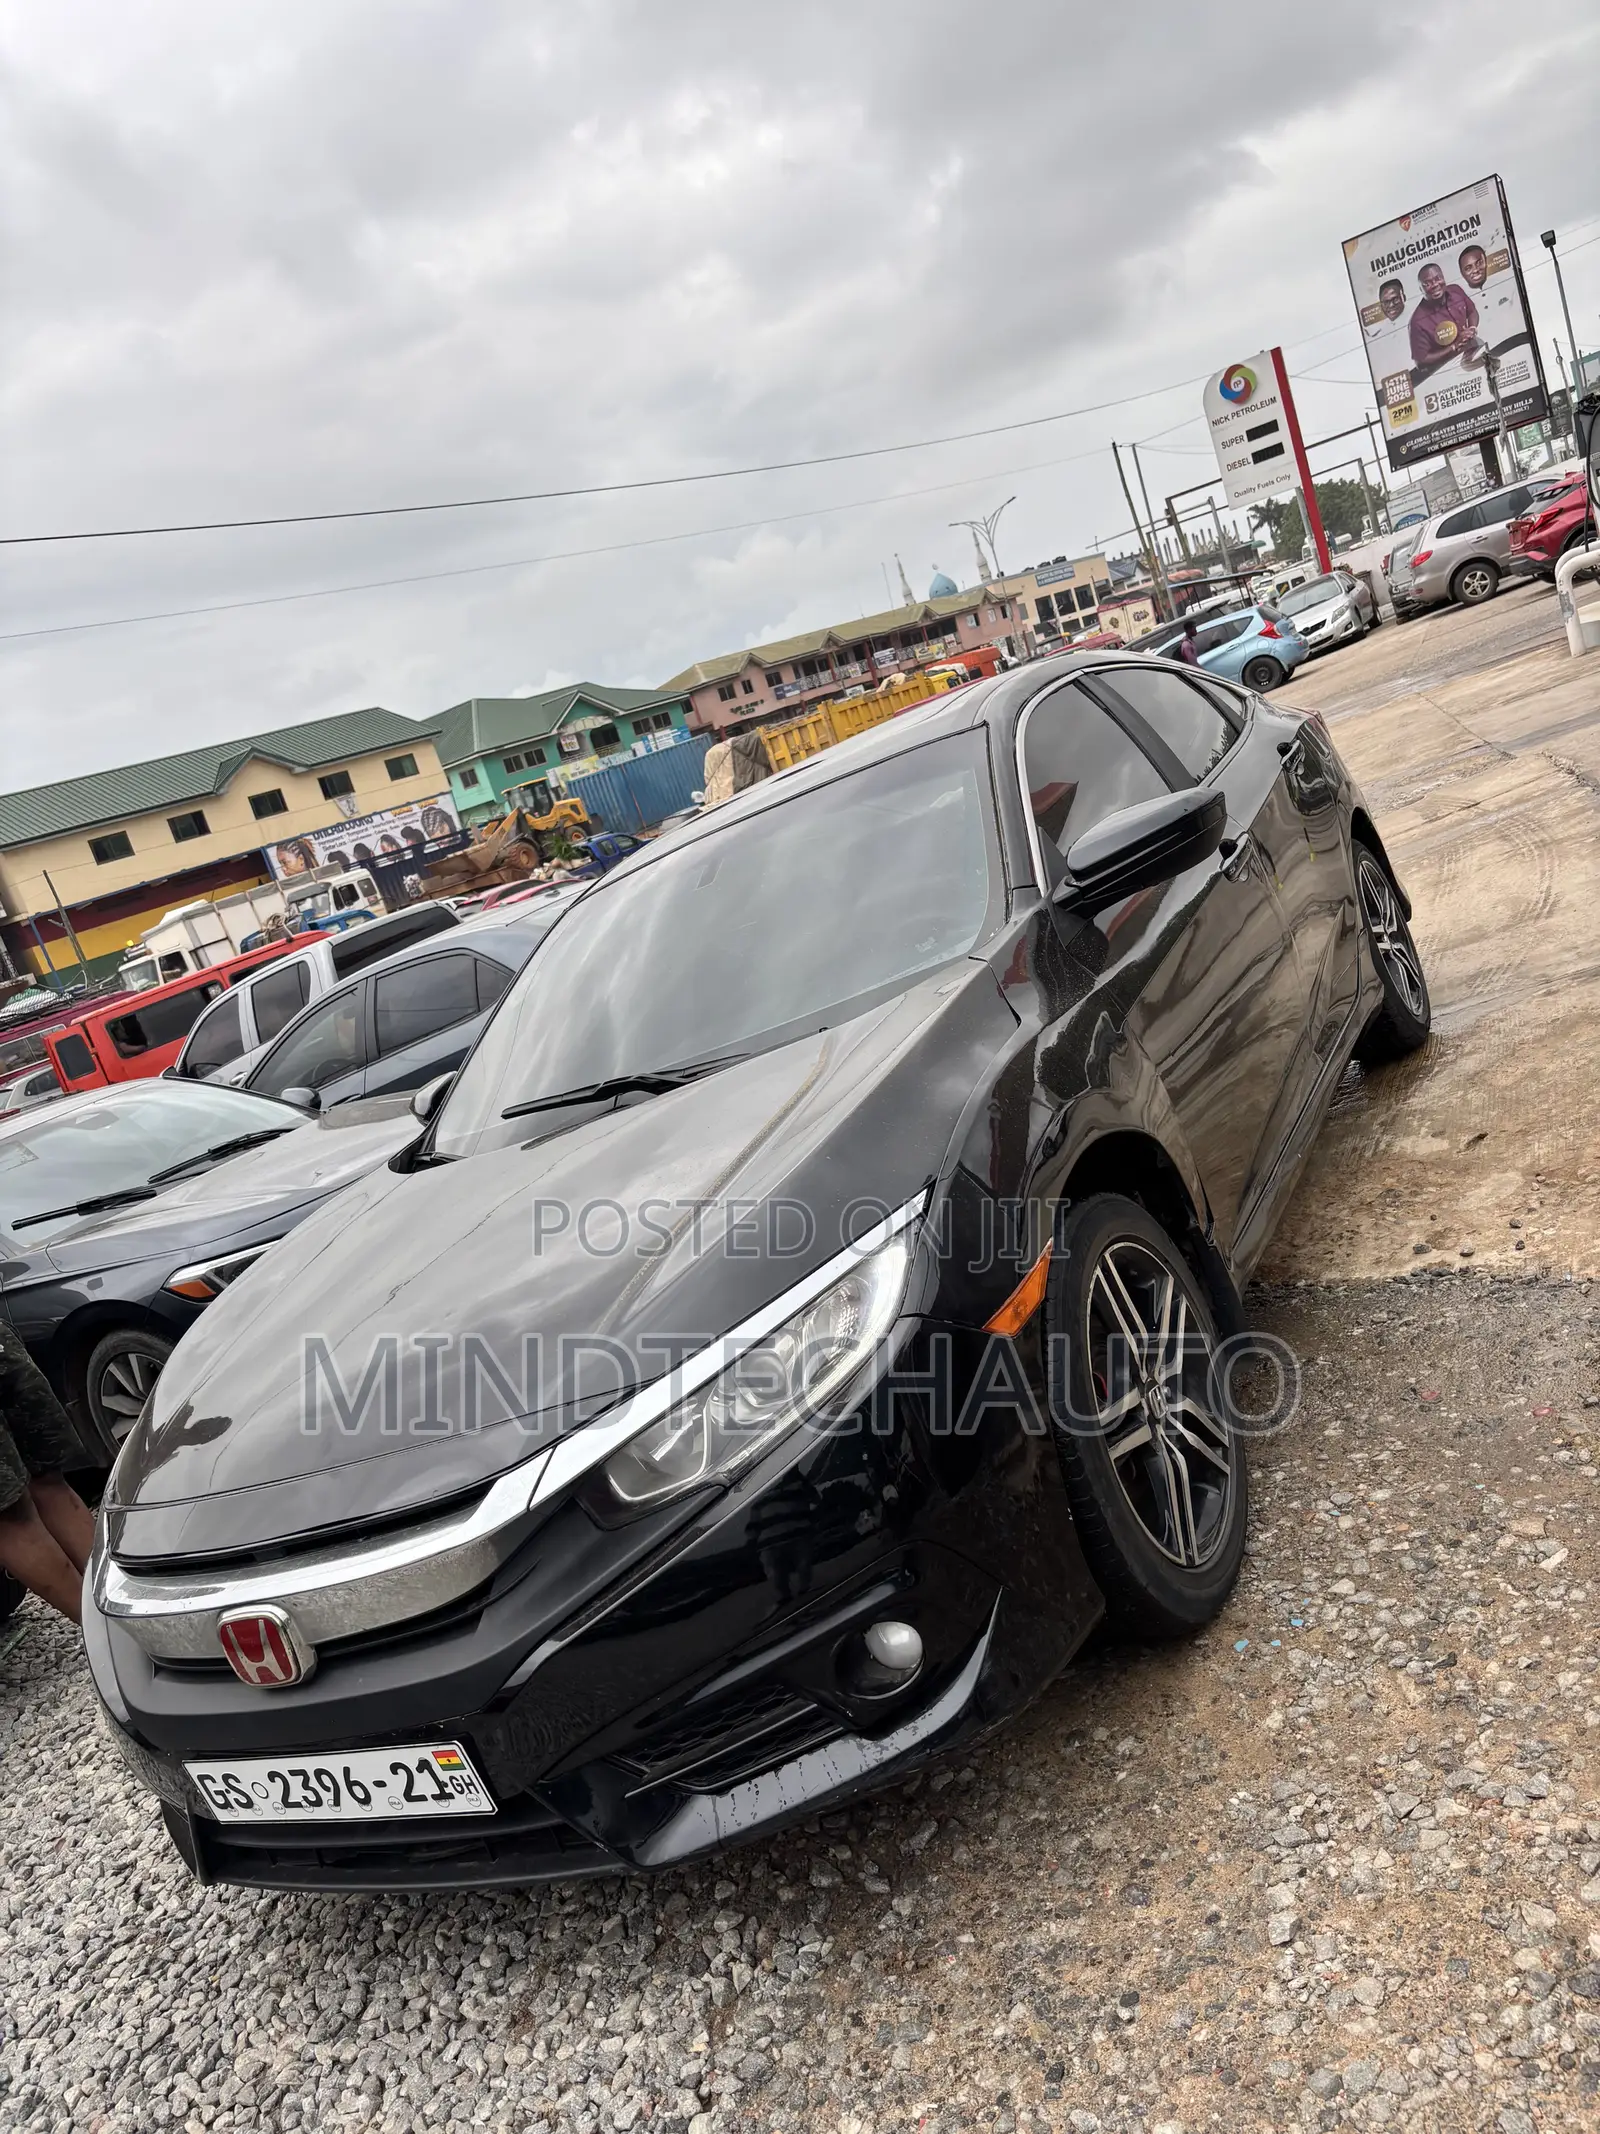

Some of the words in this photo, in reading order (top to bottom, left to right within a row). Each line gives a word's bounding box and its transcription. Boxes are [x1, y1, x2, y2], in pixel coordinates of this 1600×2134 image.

[1370, 213, 1481, 273] INAUGURATION
[1377, 268, 1388, 278] OF
[1389, 261, 1406, 273] NEW
[1407, 246, 1440, 265] CHURCH
[1440, 229, 1479, 251] BUILDING
[1384, 373, 1407, 389] 14TH
[1386, 381, 1410, 397] JUNE
[1387, 390, 1411, 405] 2026
[1440, 391, 1456, 402] ALL
[1456, 382, 1482, 397] NIGHT
[1441, 389, 1482, 409] SERVICES
[1211, 413, 1230, 428] NICK
[1231, 396, 1277, 420] PETROLEUM
[1392, 405, 1413, 419] 2PM
[1425, 395, 1438, 413] 3
[1406, 435, 1430, 447] GLOBAL
[1431, 424, 1455, 437] PRAYER
[1513, 397, 1534, 410] HILLS
[1221, 434, 1245, 450] SUPER
[1427, 444, 1439, 453] FOR
[1440, 438, 1458, 449] MORE
[1226, 457, 1251, 472] DIESEL
[1233, 485, 1256, 498] Quality
[1257, 479, 1275, 491] Fuels
[1275, 473, 1291, 485] Only
[196, 1772, 254, 1810] GS
[449, 1774, 480, 1795] GH
